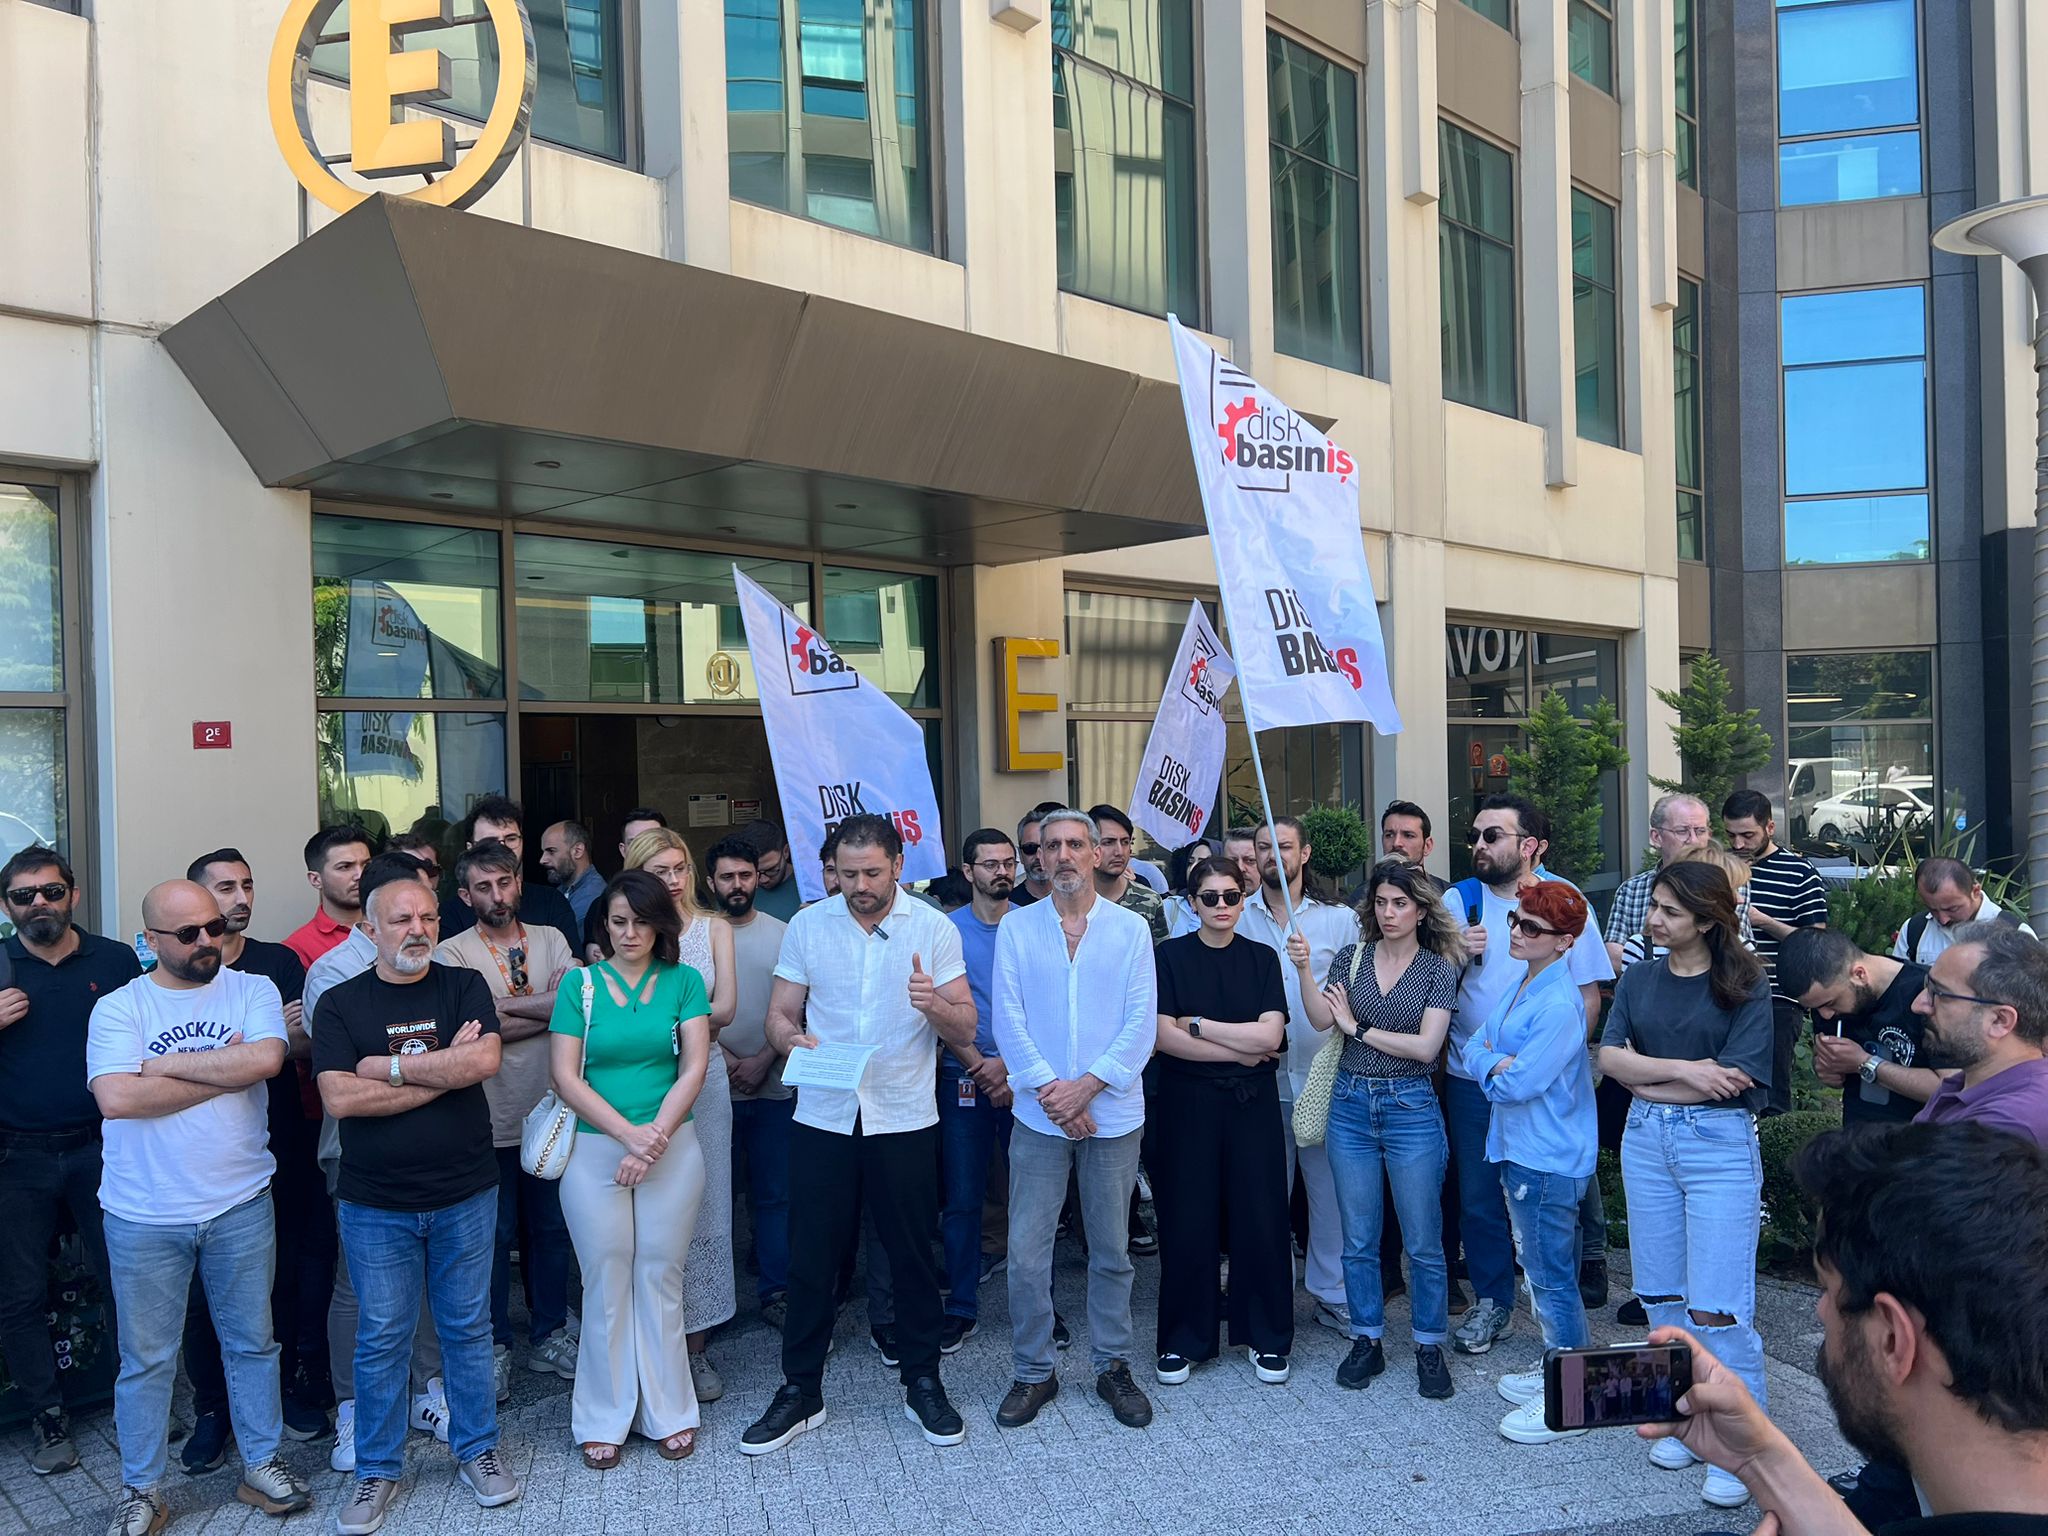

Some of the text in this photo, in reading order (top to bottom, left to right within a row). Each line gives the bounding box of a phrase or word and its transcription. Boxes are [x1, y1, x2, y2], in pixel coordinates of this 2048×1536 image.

[349, 0, 455, 178] E
[1247, 406, 1302, 442] disk
[1001, 637, 1063, 771] E
[386, 1021, 437, 1035] WORLDWIDE
